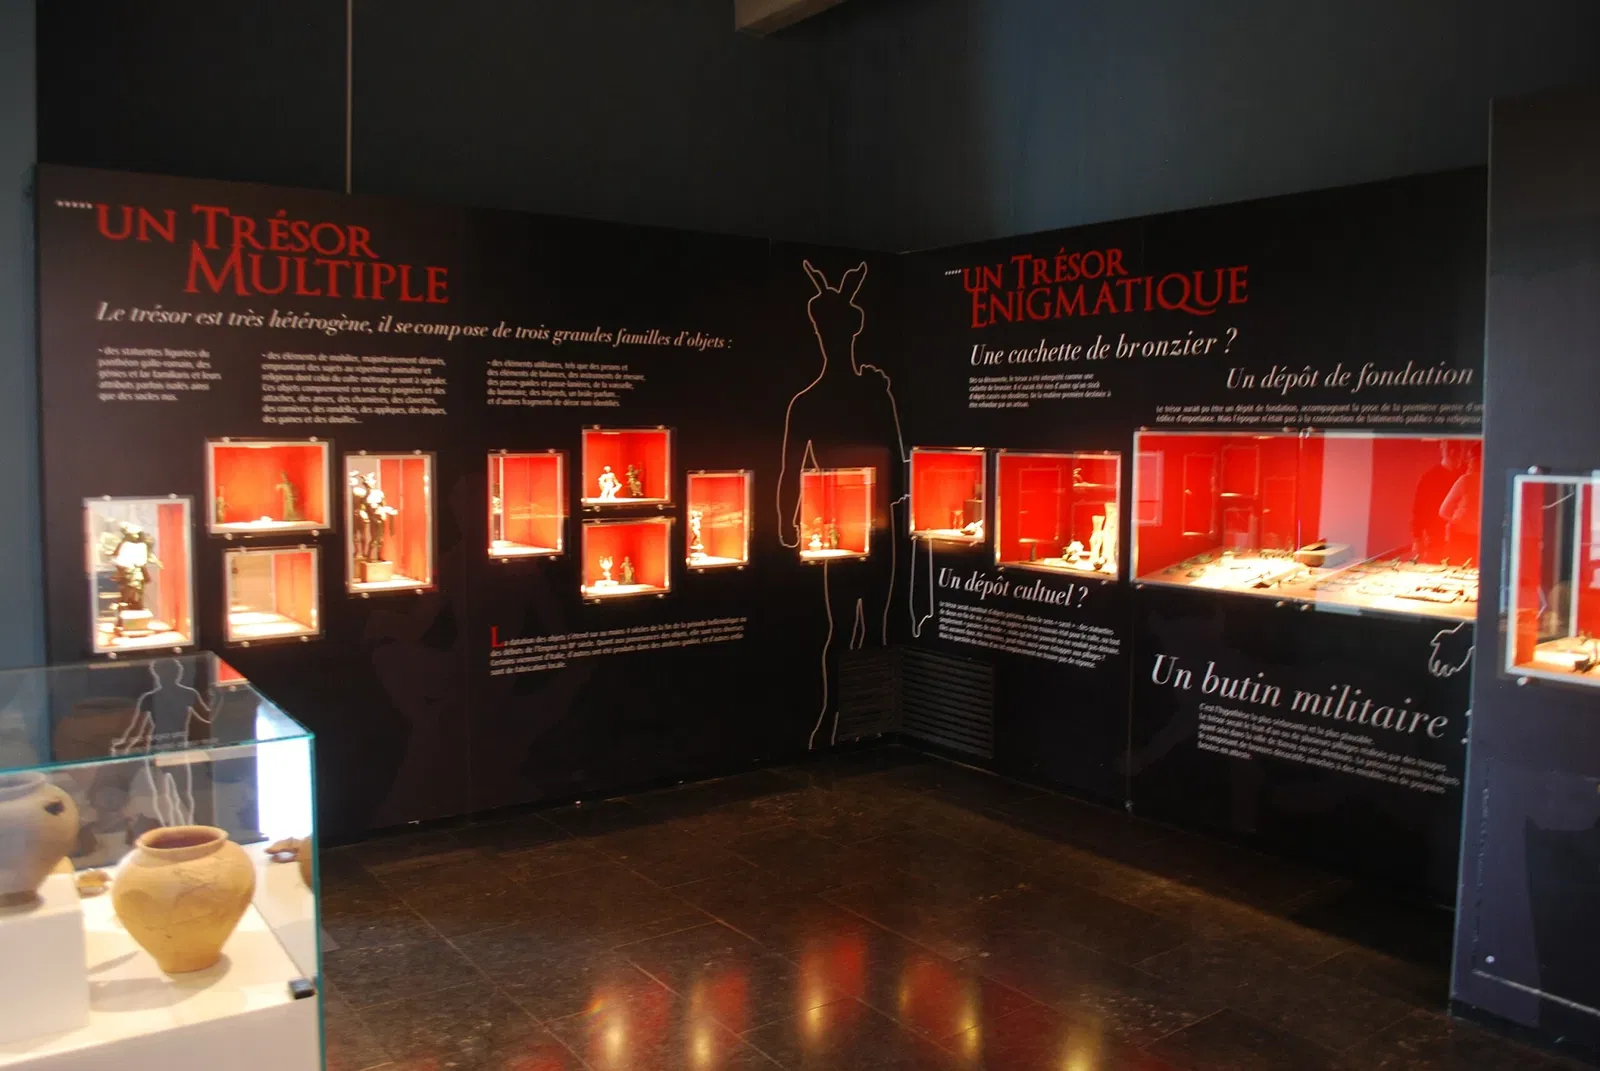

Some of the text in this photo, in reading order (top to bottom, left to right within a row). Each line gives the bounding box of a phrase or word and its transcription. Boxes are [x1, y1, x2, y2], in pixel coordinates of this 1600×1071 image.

[96, 204, 176, 243] UN
[185, 240, 449, 303] MULTIPLE
[962, 264, 1002, 293] UN
[97, 302, 126, 322] Le
[131, 305, 192, 325] trésor
[195, 309, 223, 325] est
[228, 310, 263, 328] très
[269, 309, 373, 335] hétérogène,
[379, 316, 391, 333] il
[492, 321, 512, 337] de
[515, 326, 549, 340] trois
[552, 324, 612, 346] grandes
[613, 329, 671, 346] familles
[674, 330, 723, 350] d'objets
[971, 327, 1238, 365] Une cachette de bronzier ?
[1227, 361, 1474, 395] Un dépôt de fondation
[939, 568, 1088, 608] Un dépôt cultuel ?
[1152, 653, 1191, 691] Un
[1202, 661, 1281, 706] butin
[1291, 684, 1448, 739] militaire
